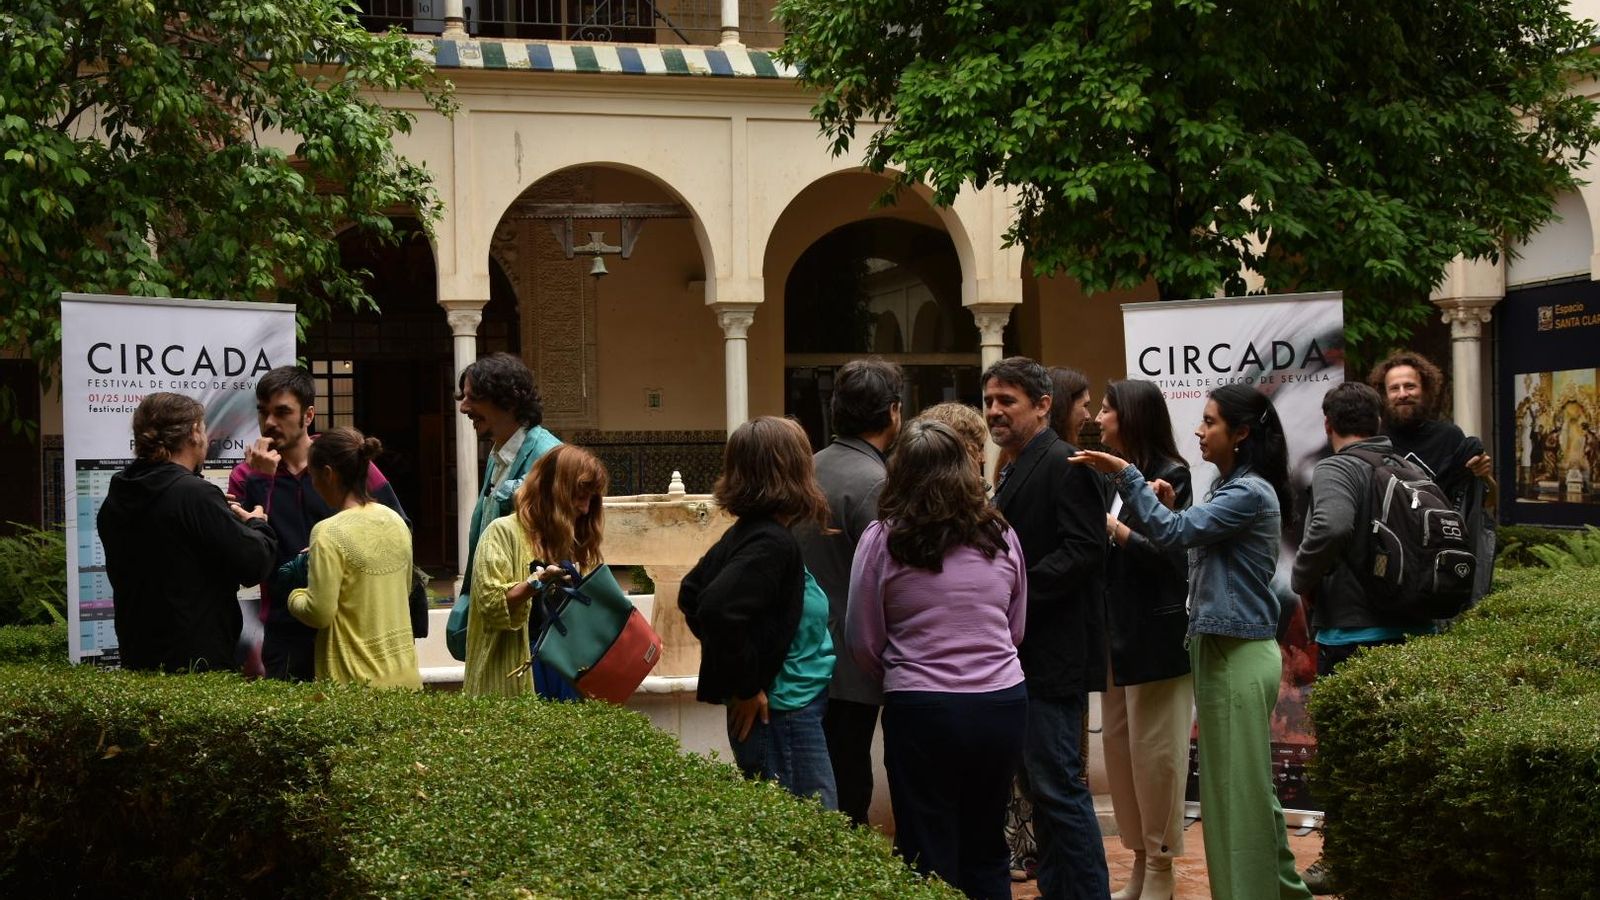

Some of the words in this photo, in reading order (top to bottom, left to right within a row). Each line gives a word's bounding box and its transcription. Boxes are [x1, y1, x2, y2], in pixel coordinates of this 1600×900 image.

[1555, 303, 1584, 314] Espacio
[1555, 317, 1581, 329] SANTA
[87, 342, 272, 377] CIRCADA
[1138, 337, 1330, 376] CIRCADA
[87, 378, 144, 389] FESTIVAL
[150, 379, 164, 389] DE
[170, 380, 207, 390] CIRCO
[213, 381, 226, 390] DE
[233, 381, 257, 390] SEVI
[1153, 379, 1191, 388] TIVAL
[1197, 378, 1211, 387] DE
[1217, 376, 1254, 386] CIRCO
[1260, 375, 1275, 385] DE
[1281, 374, 1330, 384] SEVILLA
[88, 393, 119, 404] 01/25
[122, 394, 146, 403] JUN
[1170, 390, 1202, 400] JUNIO
[88, 404, 137, 413] festivalci
